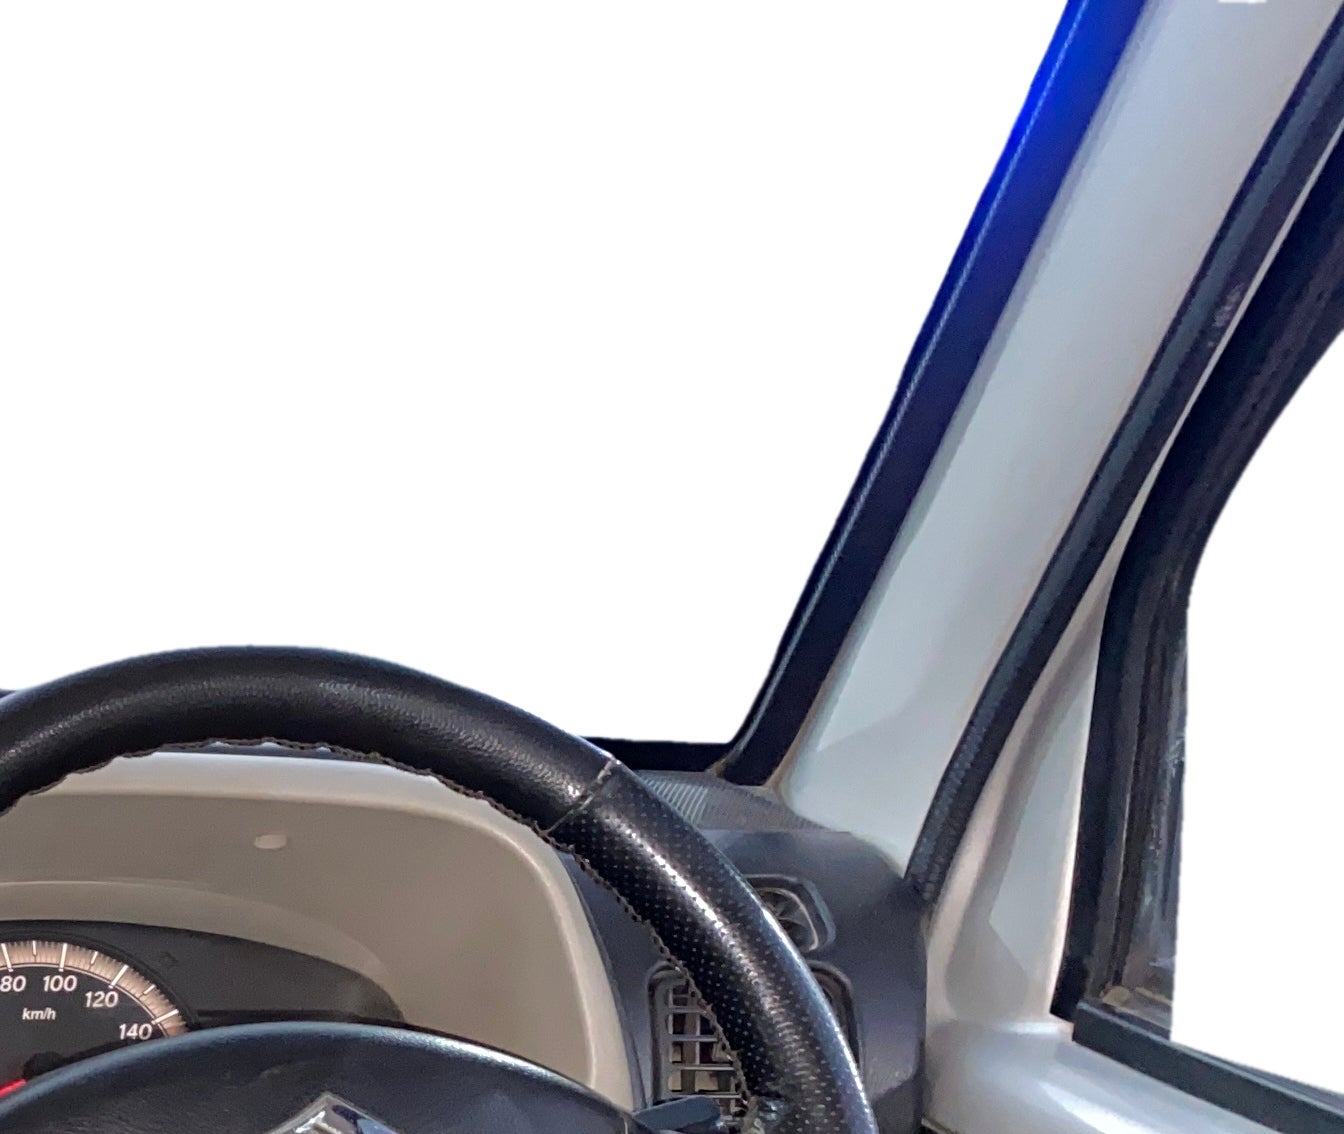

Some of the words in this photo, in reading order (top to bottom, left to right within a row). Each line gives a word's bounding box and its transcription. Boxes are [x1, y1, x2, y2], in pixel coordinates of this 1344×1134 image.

[0, 974, 27, 993] 80
[43, 974, 78, 992] 100
[85, 990, 119, 1009] 120
[22, 1007, 56, 1021] km/h
[119, 1023, 153, 1041] 140
